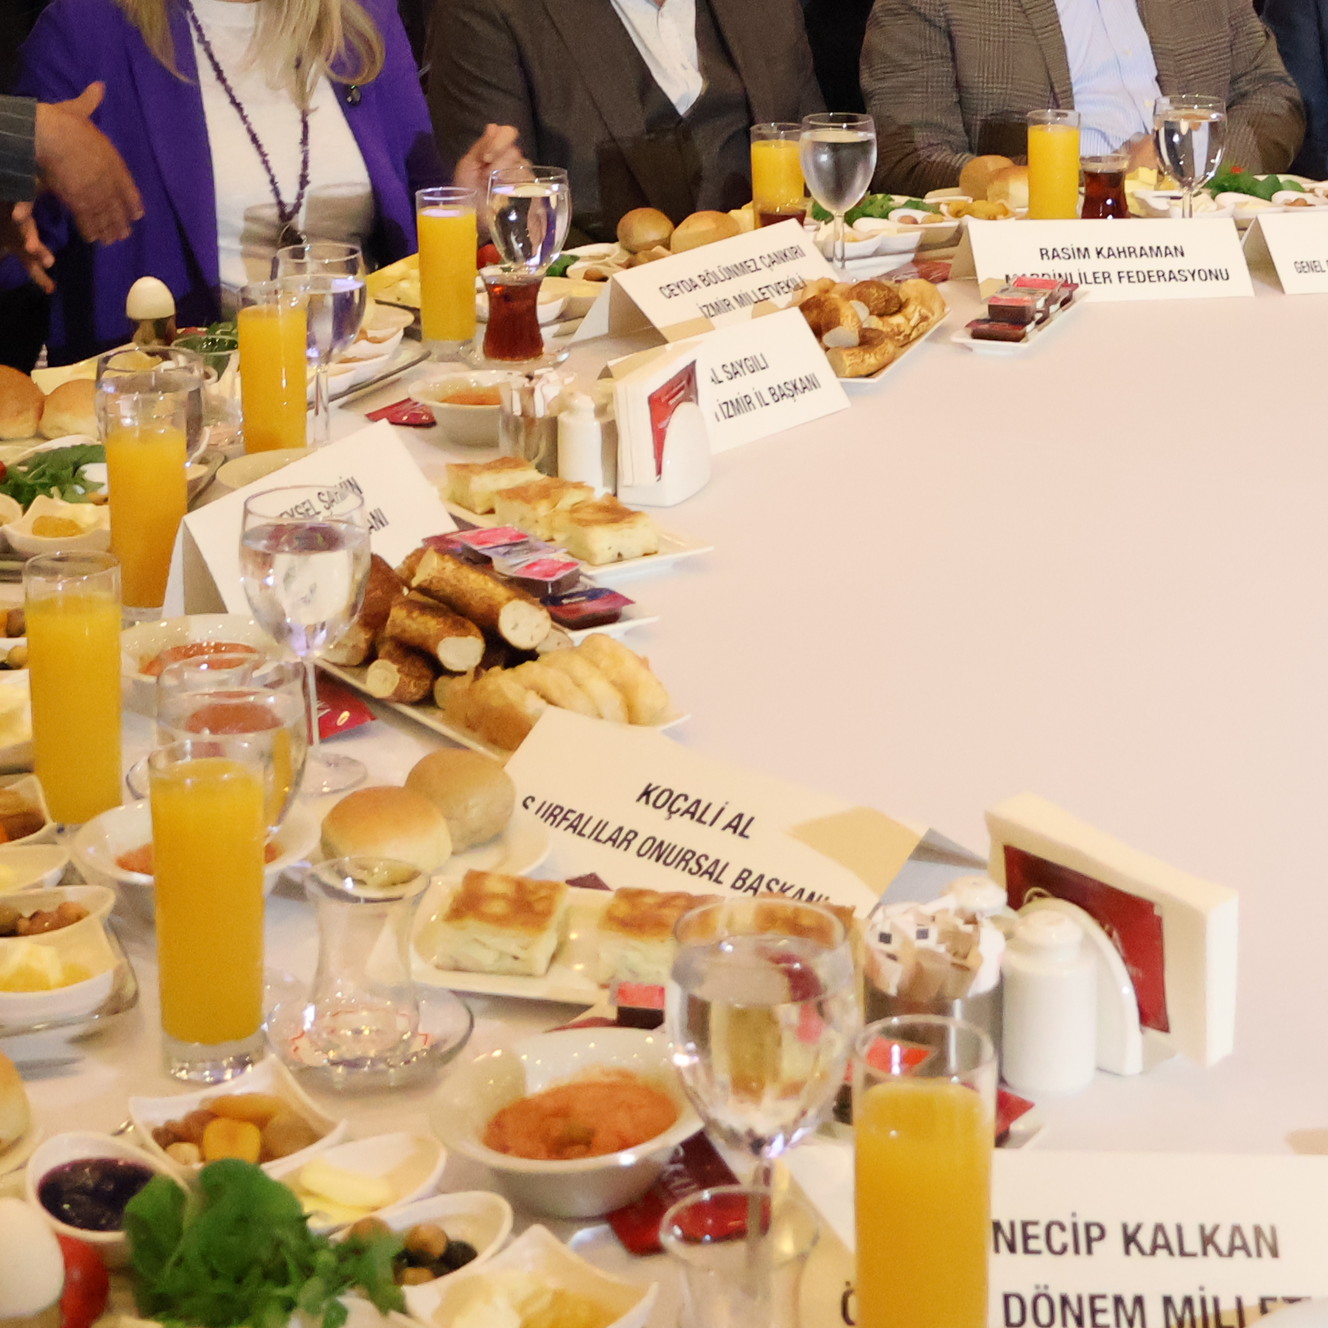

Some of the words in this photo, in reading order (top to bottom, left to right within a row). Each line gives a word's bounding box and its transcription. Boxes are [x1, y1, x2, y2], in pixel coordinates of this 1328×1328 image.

[1038, 243, 1091, 261] RASİM
[1094, 245, 1186, 261] KAHRAMAN
[1293, 259, 1327, 274] GENEL
[658, 276, 702, 299] CEYDA
[1116, 268, 1230, 285] FEDERASYONU
[716, 391, 757, 421] İZMİR
[752, 387, 770, 408] İL
[767, 371, 822, 403] BAŞKANI
[635, 782, 730, 829] KOÇALİ
[722, 812, 756, 841] AL
[635, 835, 731, 886] ONURSAL
[991, 1211, 1107, 1256] NECİP
[1121, 1221, 1281, 1260] KALKAN
[1001, 1283, 1146, 1328] DÖNEM
